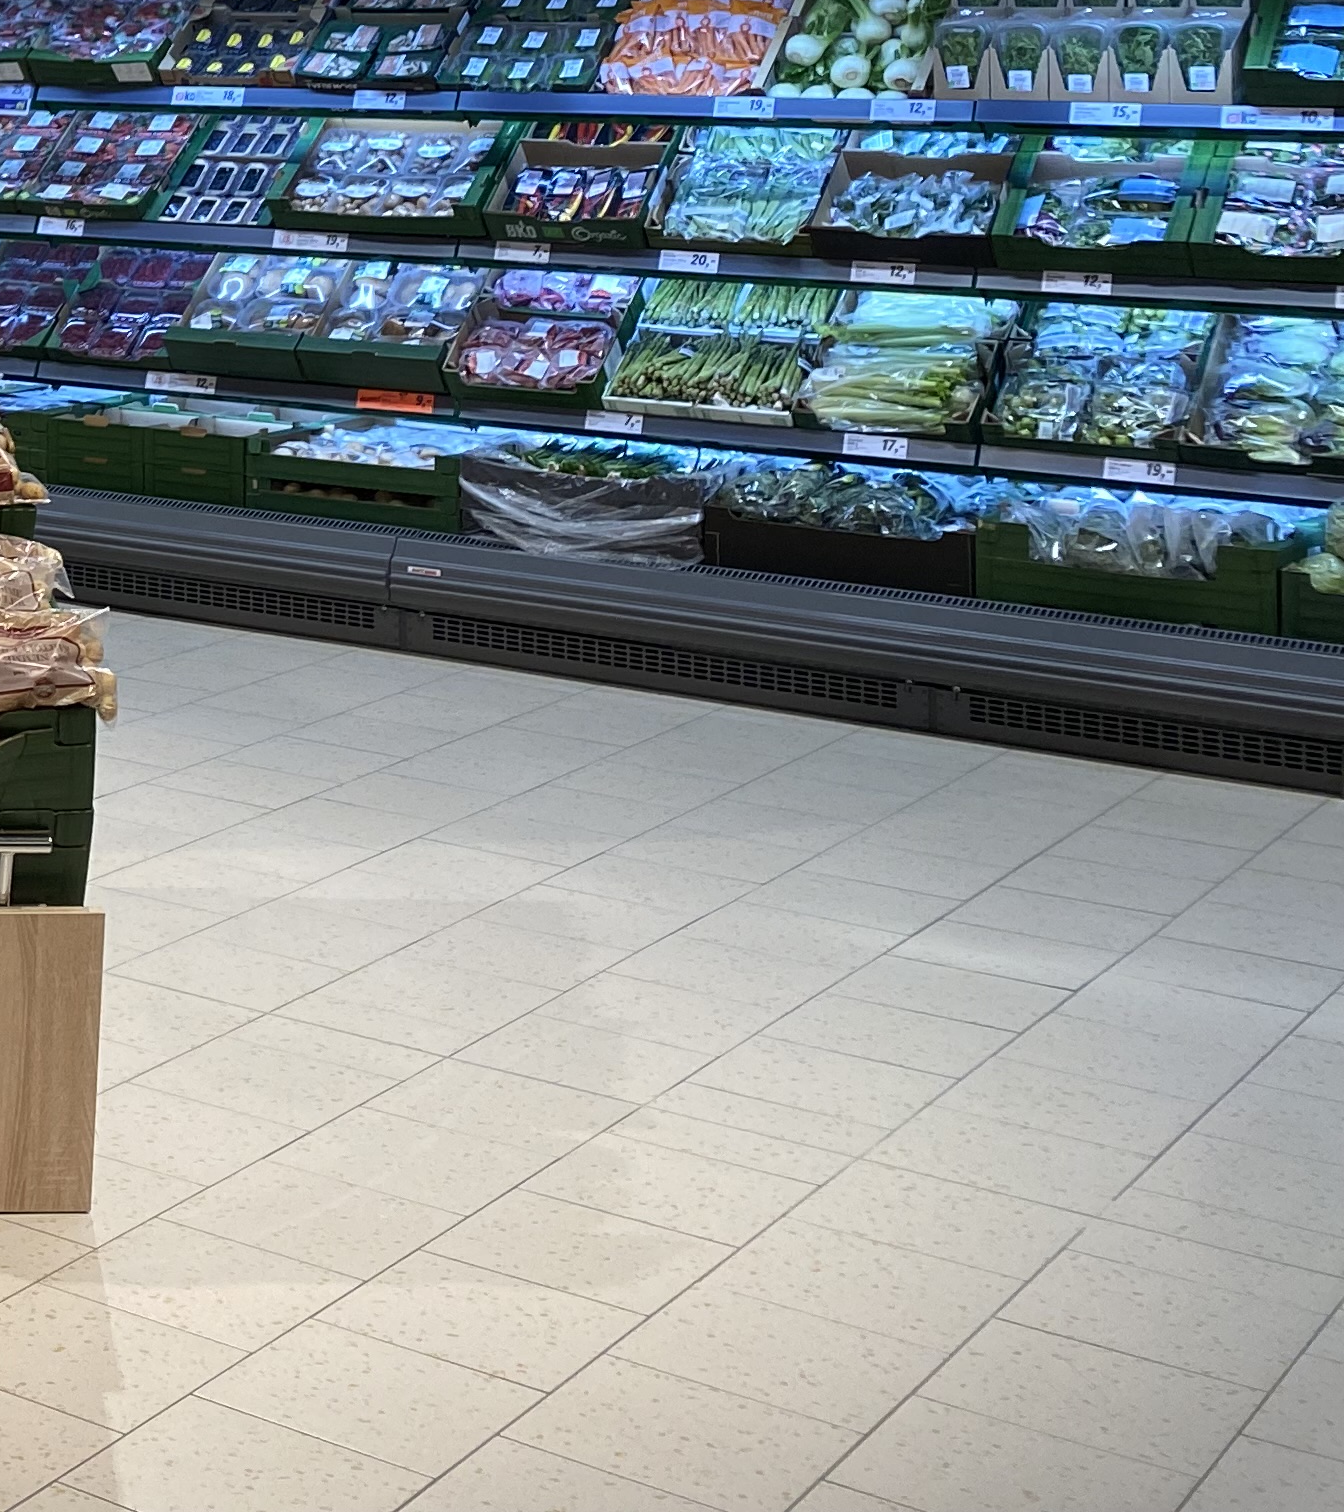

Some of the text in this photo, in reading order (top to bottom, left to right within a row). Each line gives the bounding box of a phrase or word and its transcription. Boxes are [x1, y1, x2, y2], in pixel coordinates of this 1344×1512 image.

[749, 99, 772, 113] 19,-
[909, 102, 933, 116] 12,-
[1113, 106, 1138, 119] 15,-
[65, 219, 82, 232] 16,-
[691, 254, 716, 268] 20,-
[882, 438, 907, 454] 17,-
[1146, 463, 1174, 480] 19,-
